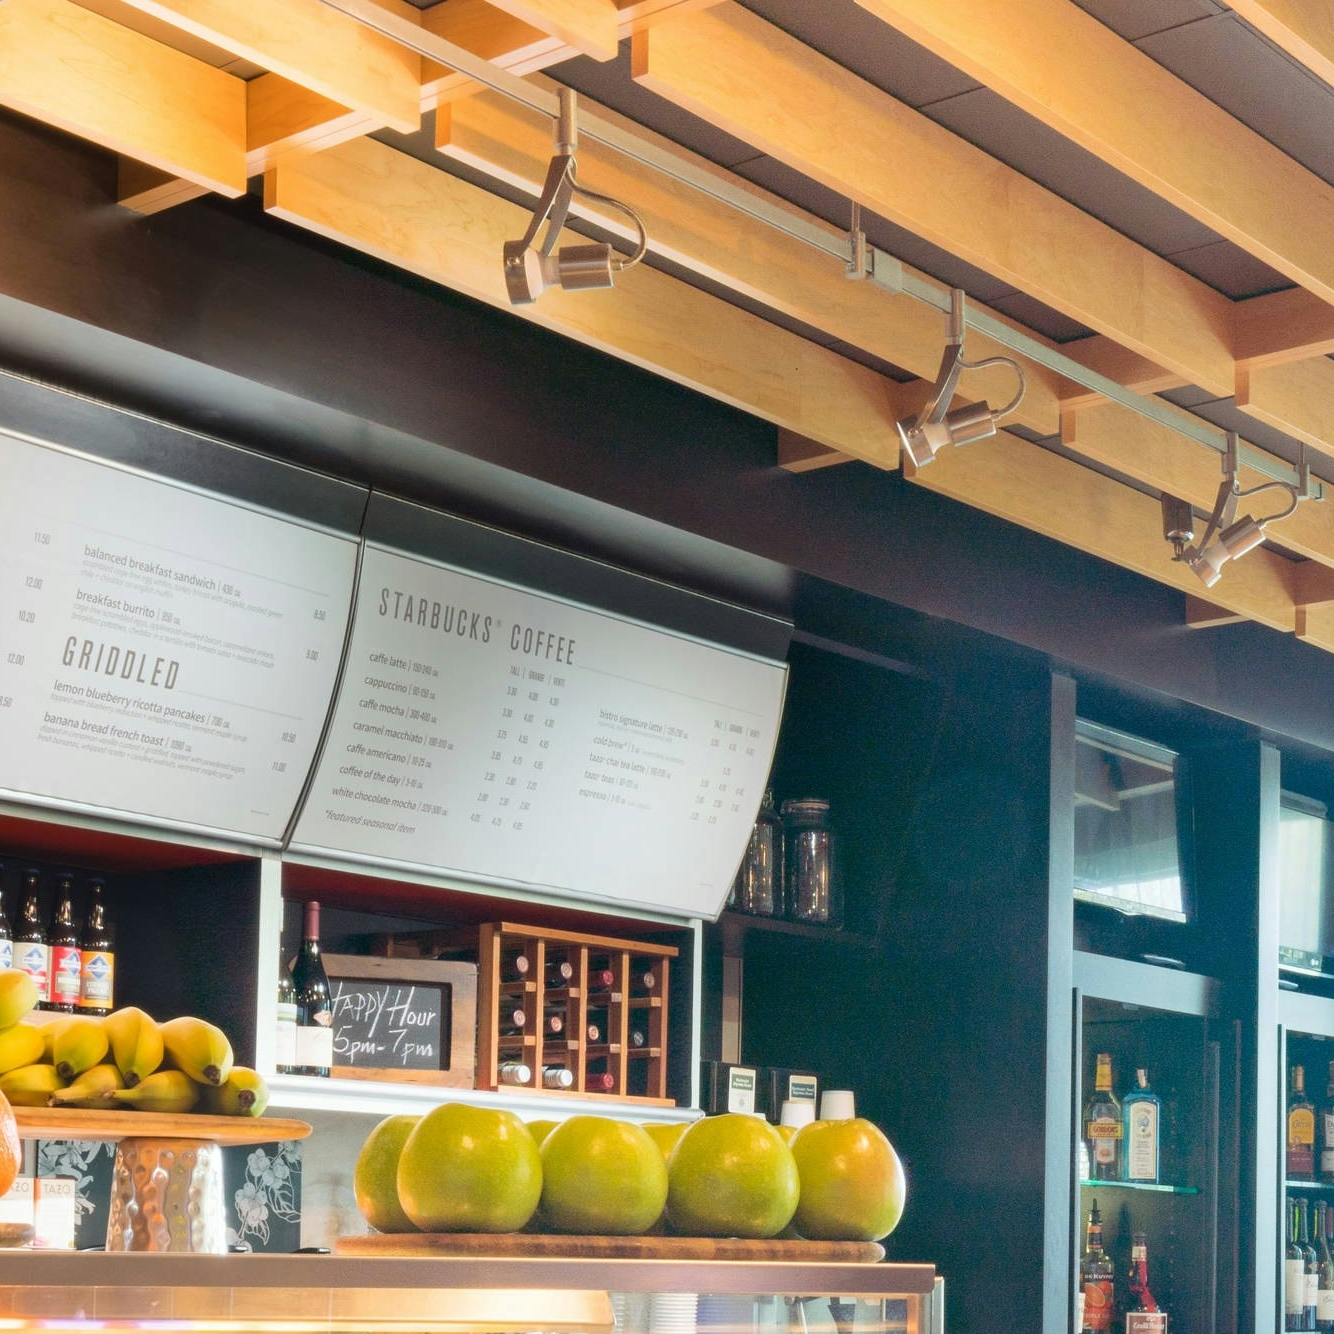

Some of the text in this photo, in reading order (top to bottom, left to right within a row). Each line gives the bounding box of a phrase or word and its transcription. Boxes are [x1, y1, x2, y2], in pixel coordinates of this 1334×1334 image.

[84, 544, 216, 591] balanced breakfast sandwich
[77, 589, 155, 619] breakfast burrito
[510, 623, 576, 666] COFFEE
[62, 635, 179, 690] GRIDDLED
[389, 655, 407, 670] latte
[364, 675, 408, 695] cappuccino
[53, 680, 206, 724] lemon blueberry ricotta pancakes
[379, 702, 404, 717] mocha
[43, 712, 164, 747] banana bread french toast
[353, 721, 423, 745] caramel macchiato
[367, 748, 406, 763] americano
[339, 764, 401, 787] coffee of the day
[332, 785, 416, 811] white chocolate mocha
[387, 986, 436, 1026] Hour
[389, 1029, 433, 1064] 7pm
